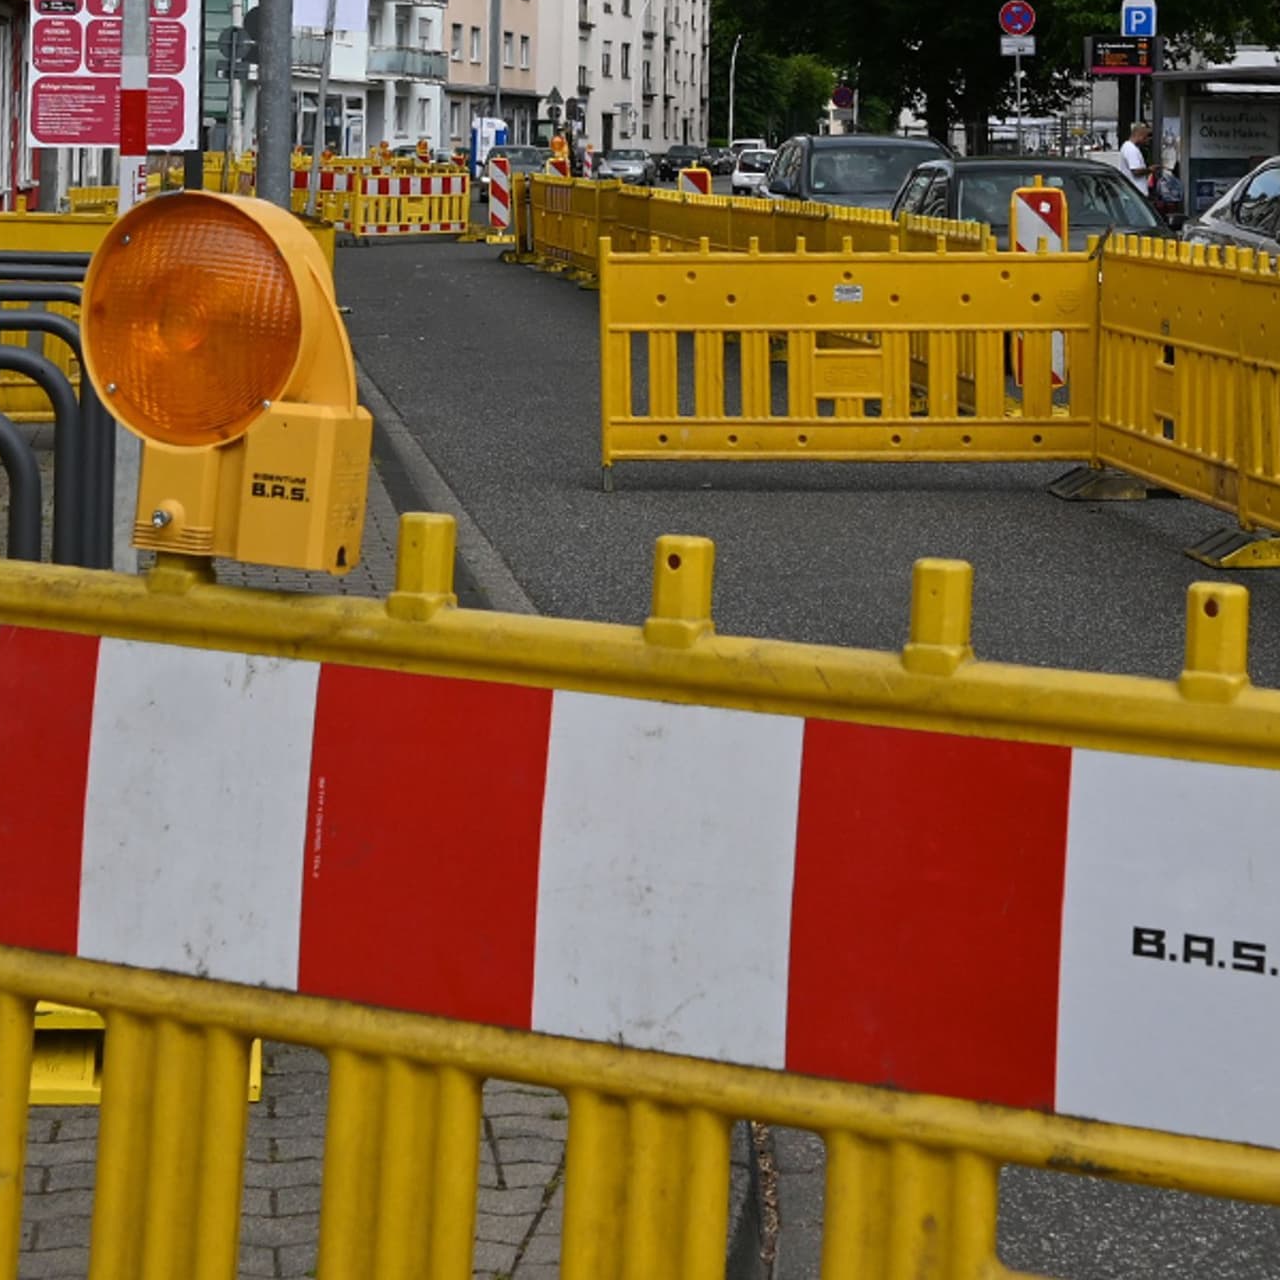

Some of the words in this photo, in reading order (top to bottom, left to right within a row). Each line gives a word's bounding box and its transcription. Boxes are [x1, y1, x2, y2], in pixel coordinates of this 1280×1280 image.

[1130, 10, 1146, 33] P
[251, 482, 309, 503] B.A.S.
[1132, 926, 1278, 977] B.A.S.
